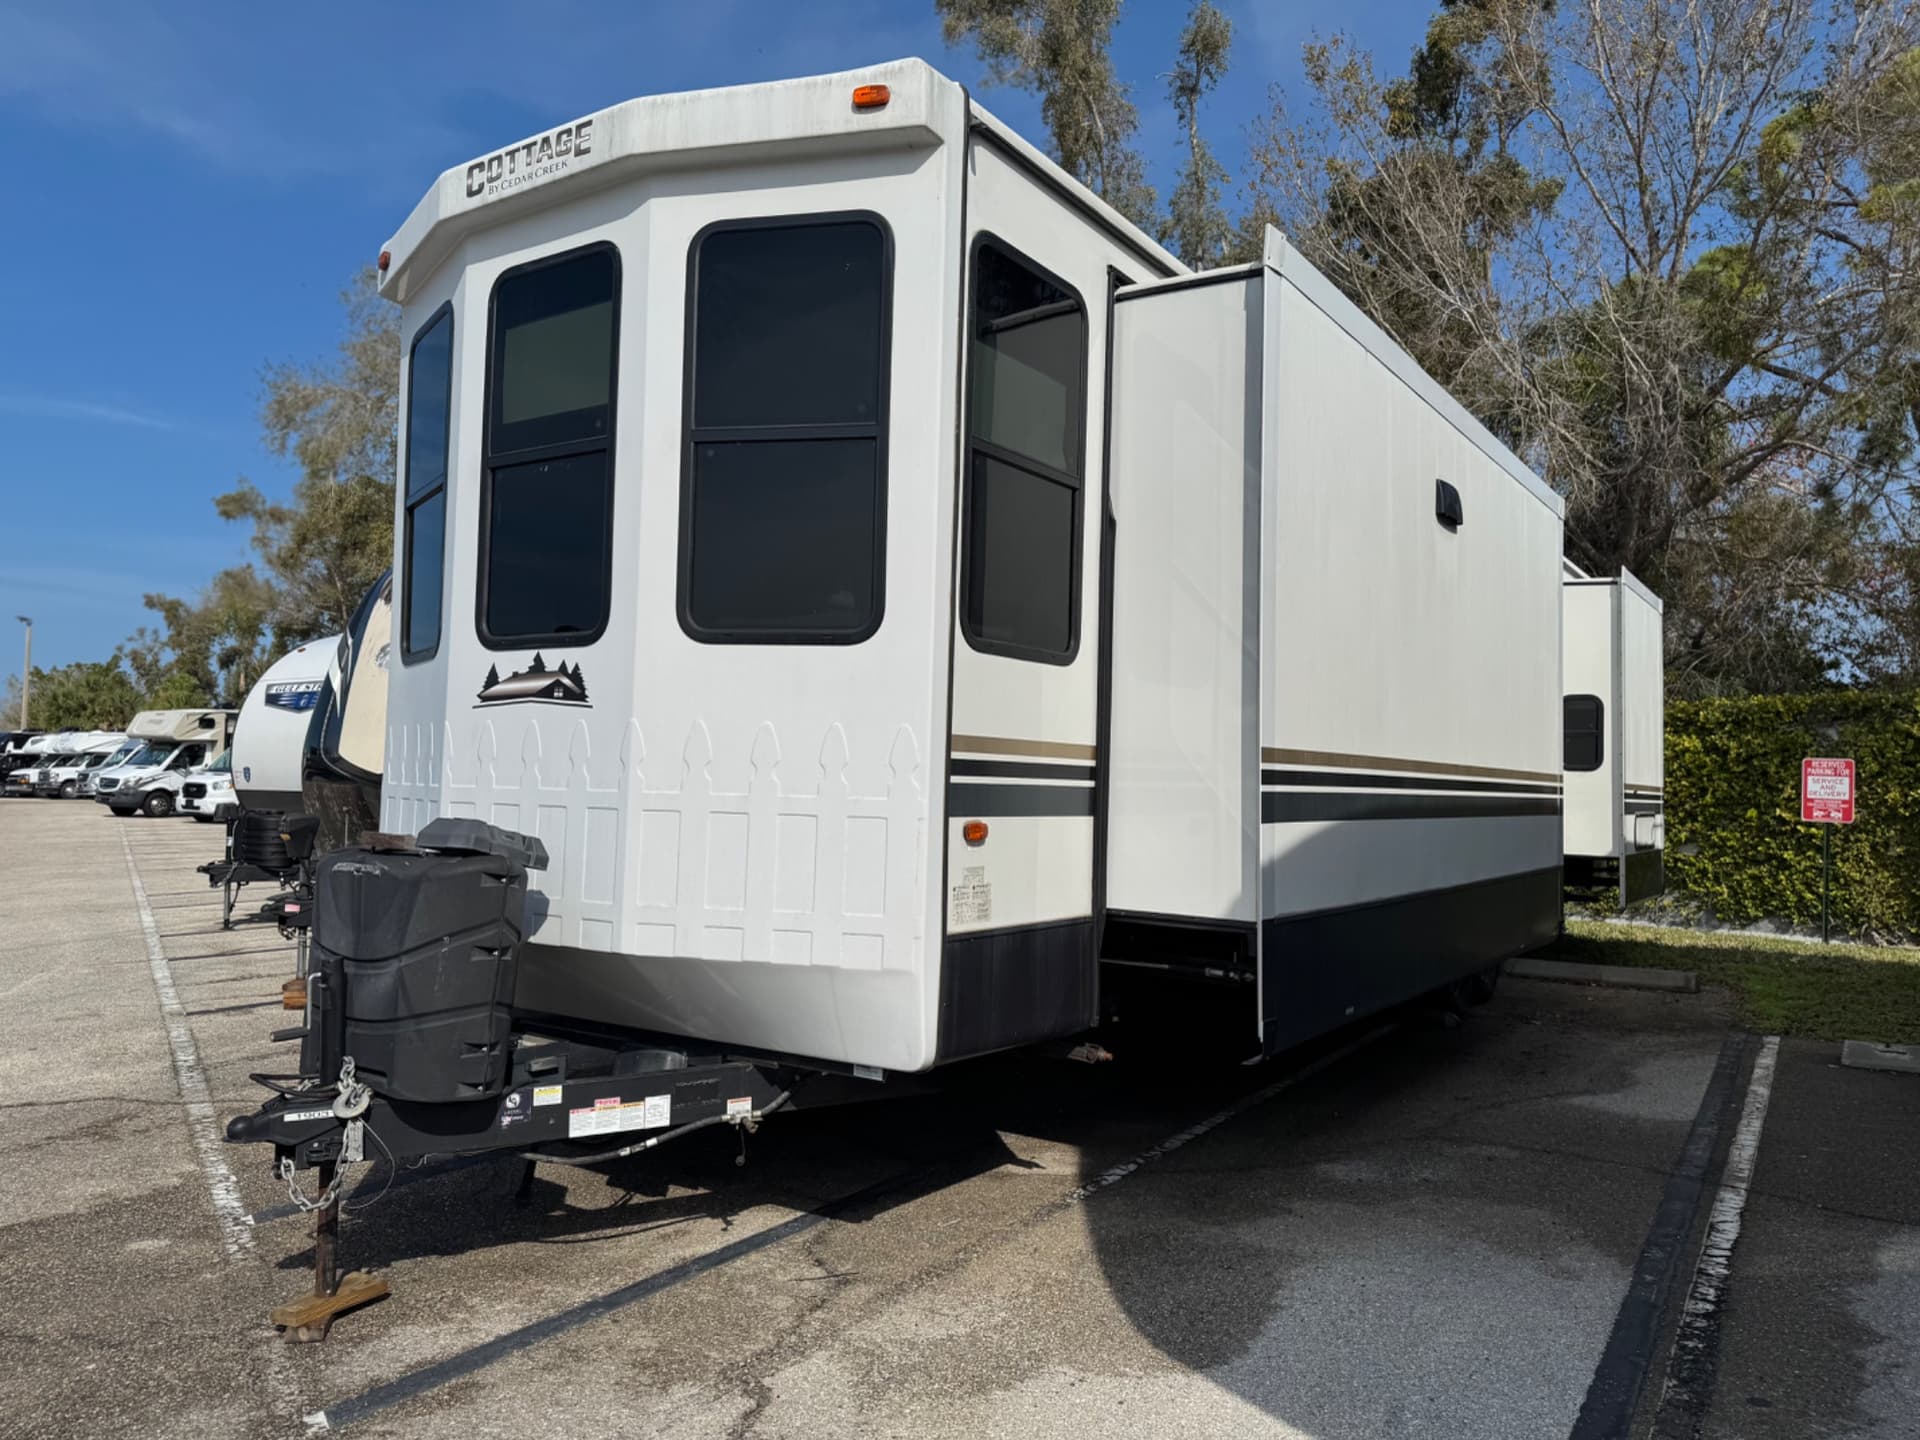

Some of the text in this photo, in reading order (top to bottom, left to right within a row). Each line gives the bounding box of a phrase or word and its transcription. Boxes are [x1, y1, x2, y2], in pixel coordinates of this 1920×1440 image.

[466, 119, 593, 198] COTTAGE
[488, 184, 501, 195] BY
[535, 159, 569, 178] CREEK
